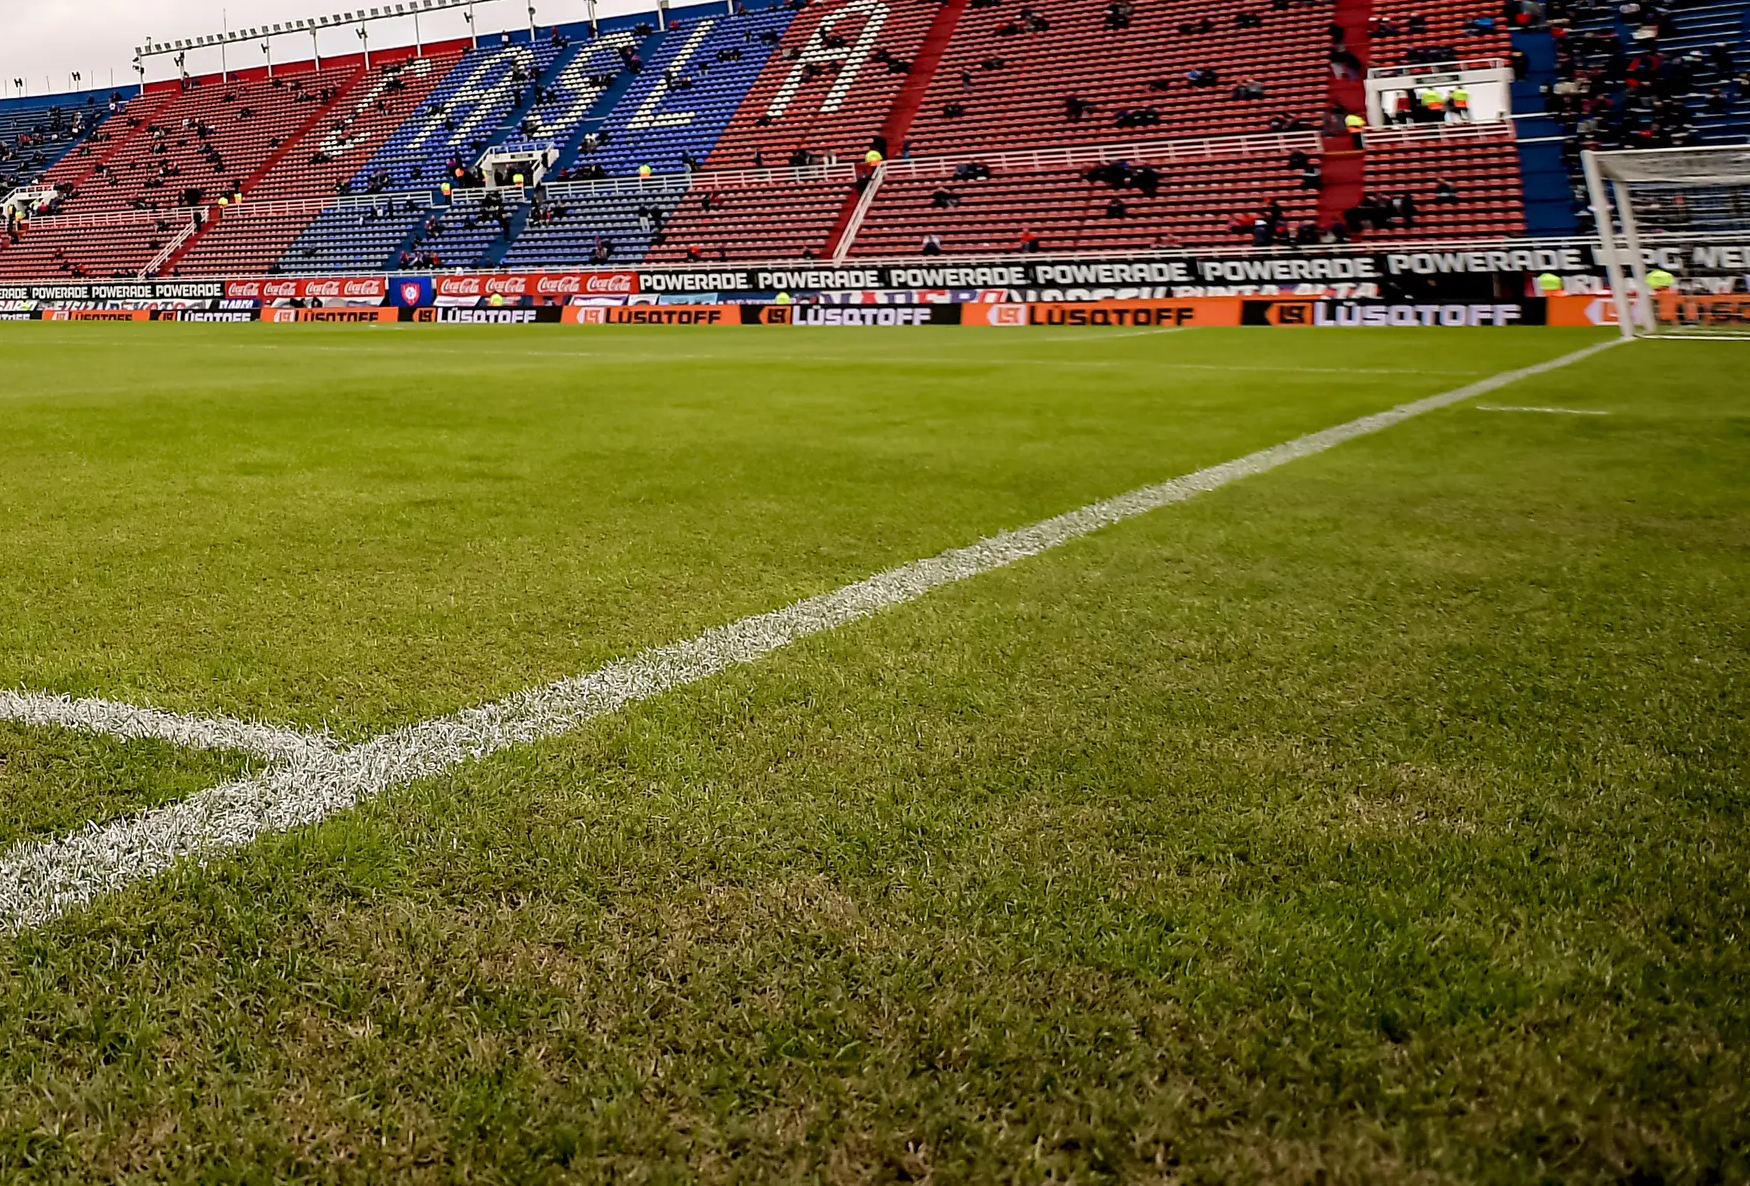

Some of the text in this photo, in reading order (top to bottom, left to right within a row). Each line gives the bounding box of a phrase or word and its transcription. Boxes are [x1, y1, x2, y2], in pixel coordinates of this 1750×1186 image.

[1204, 258, 1375, 281] POWERADE
[1388, 249, 1581, 274] POWERADE
[640, 273, 748, 291] POWERADE
[758, 270, 879, 289] POWERADE
[890, 267, 1024, 287] POWERADE
[1036, 262, 1188, 284] POWERADE
[32, 286, 89, 299] POWERADE
[92, 286, 152, 298] POWERADE
[155, 285, 221, 297] POWERADE
[437, 307, 537, 323] LÜSQTOFF
[606, 307, 721, 324] LÜSQTOFF
[792, 305, 931, 325] LÜSQTOFF
[1030, 305, 1193, 325] LÜSQTOFF
[1314, 301, 1521, 326] LÜSQTOFF
